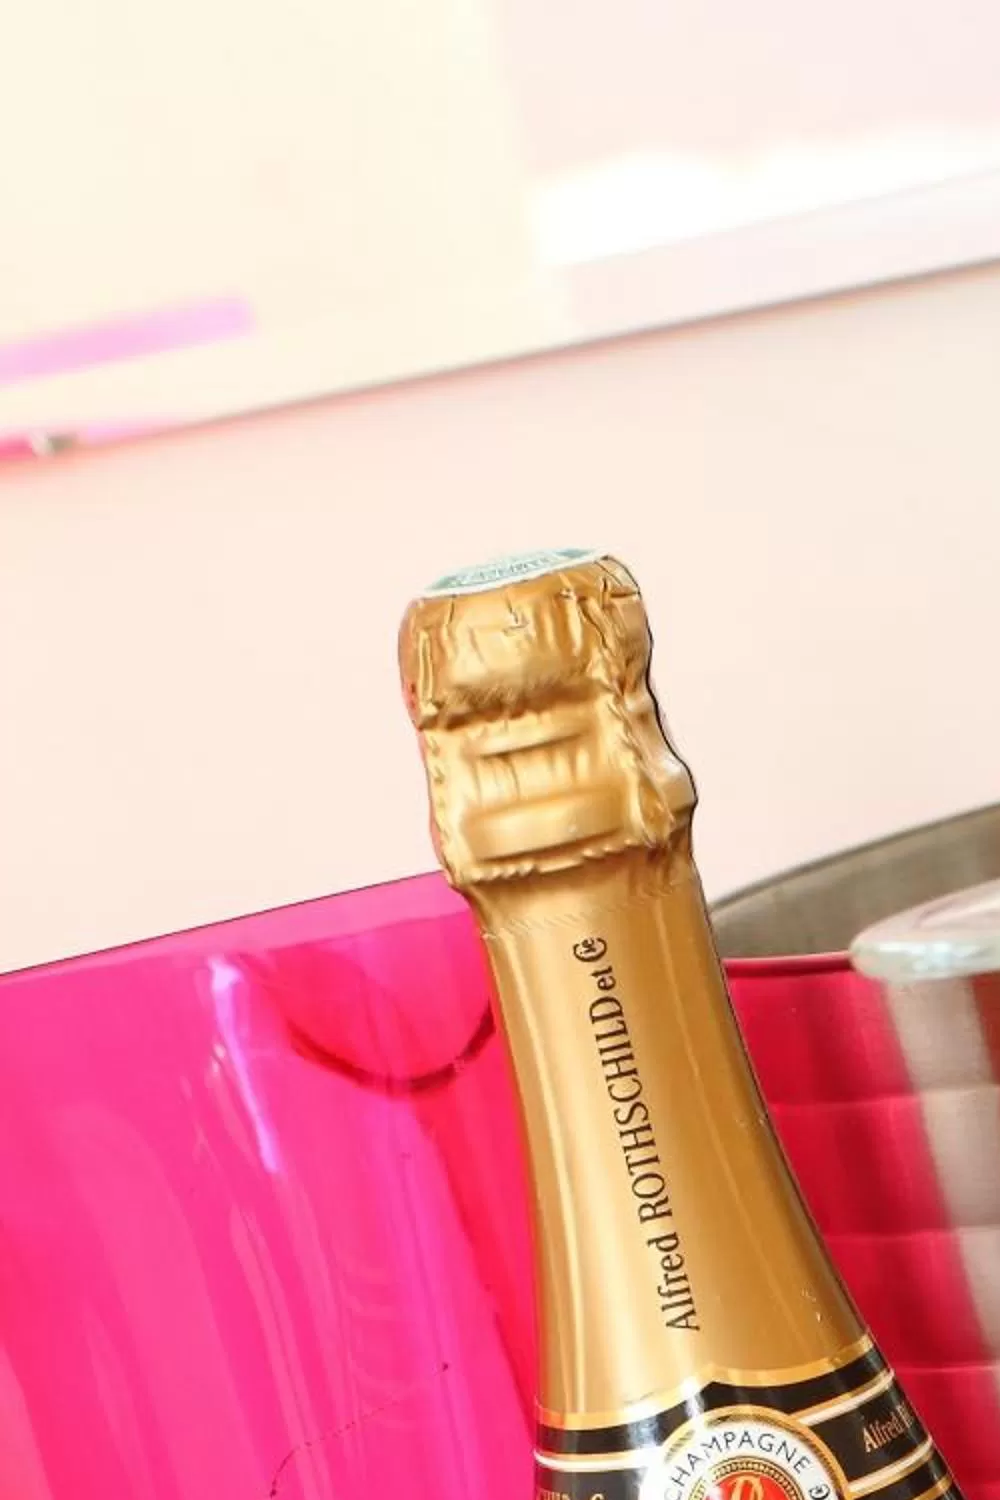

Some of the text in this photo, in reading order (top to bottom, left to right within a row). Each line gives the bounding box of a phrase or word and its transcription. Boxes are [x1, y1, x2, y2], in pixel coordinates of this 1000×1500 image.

[590, 966, 616, 991] et
[589, 996, 674, 1225] ROTHSCHILD
[647, 1232, 700, 1331] Alfred
